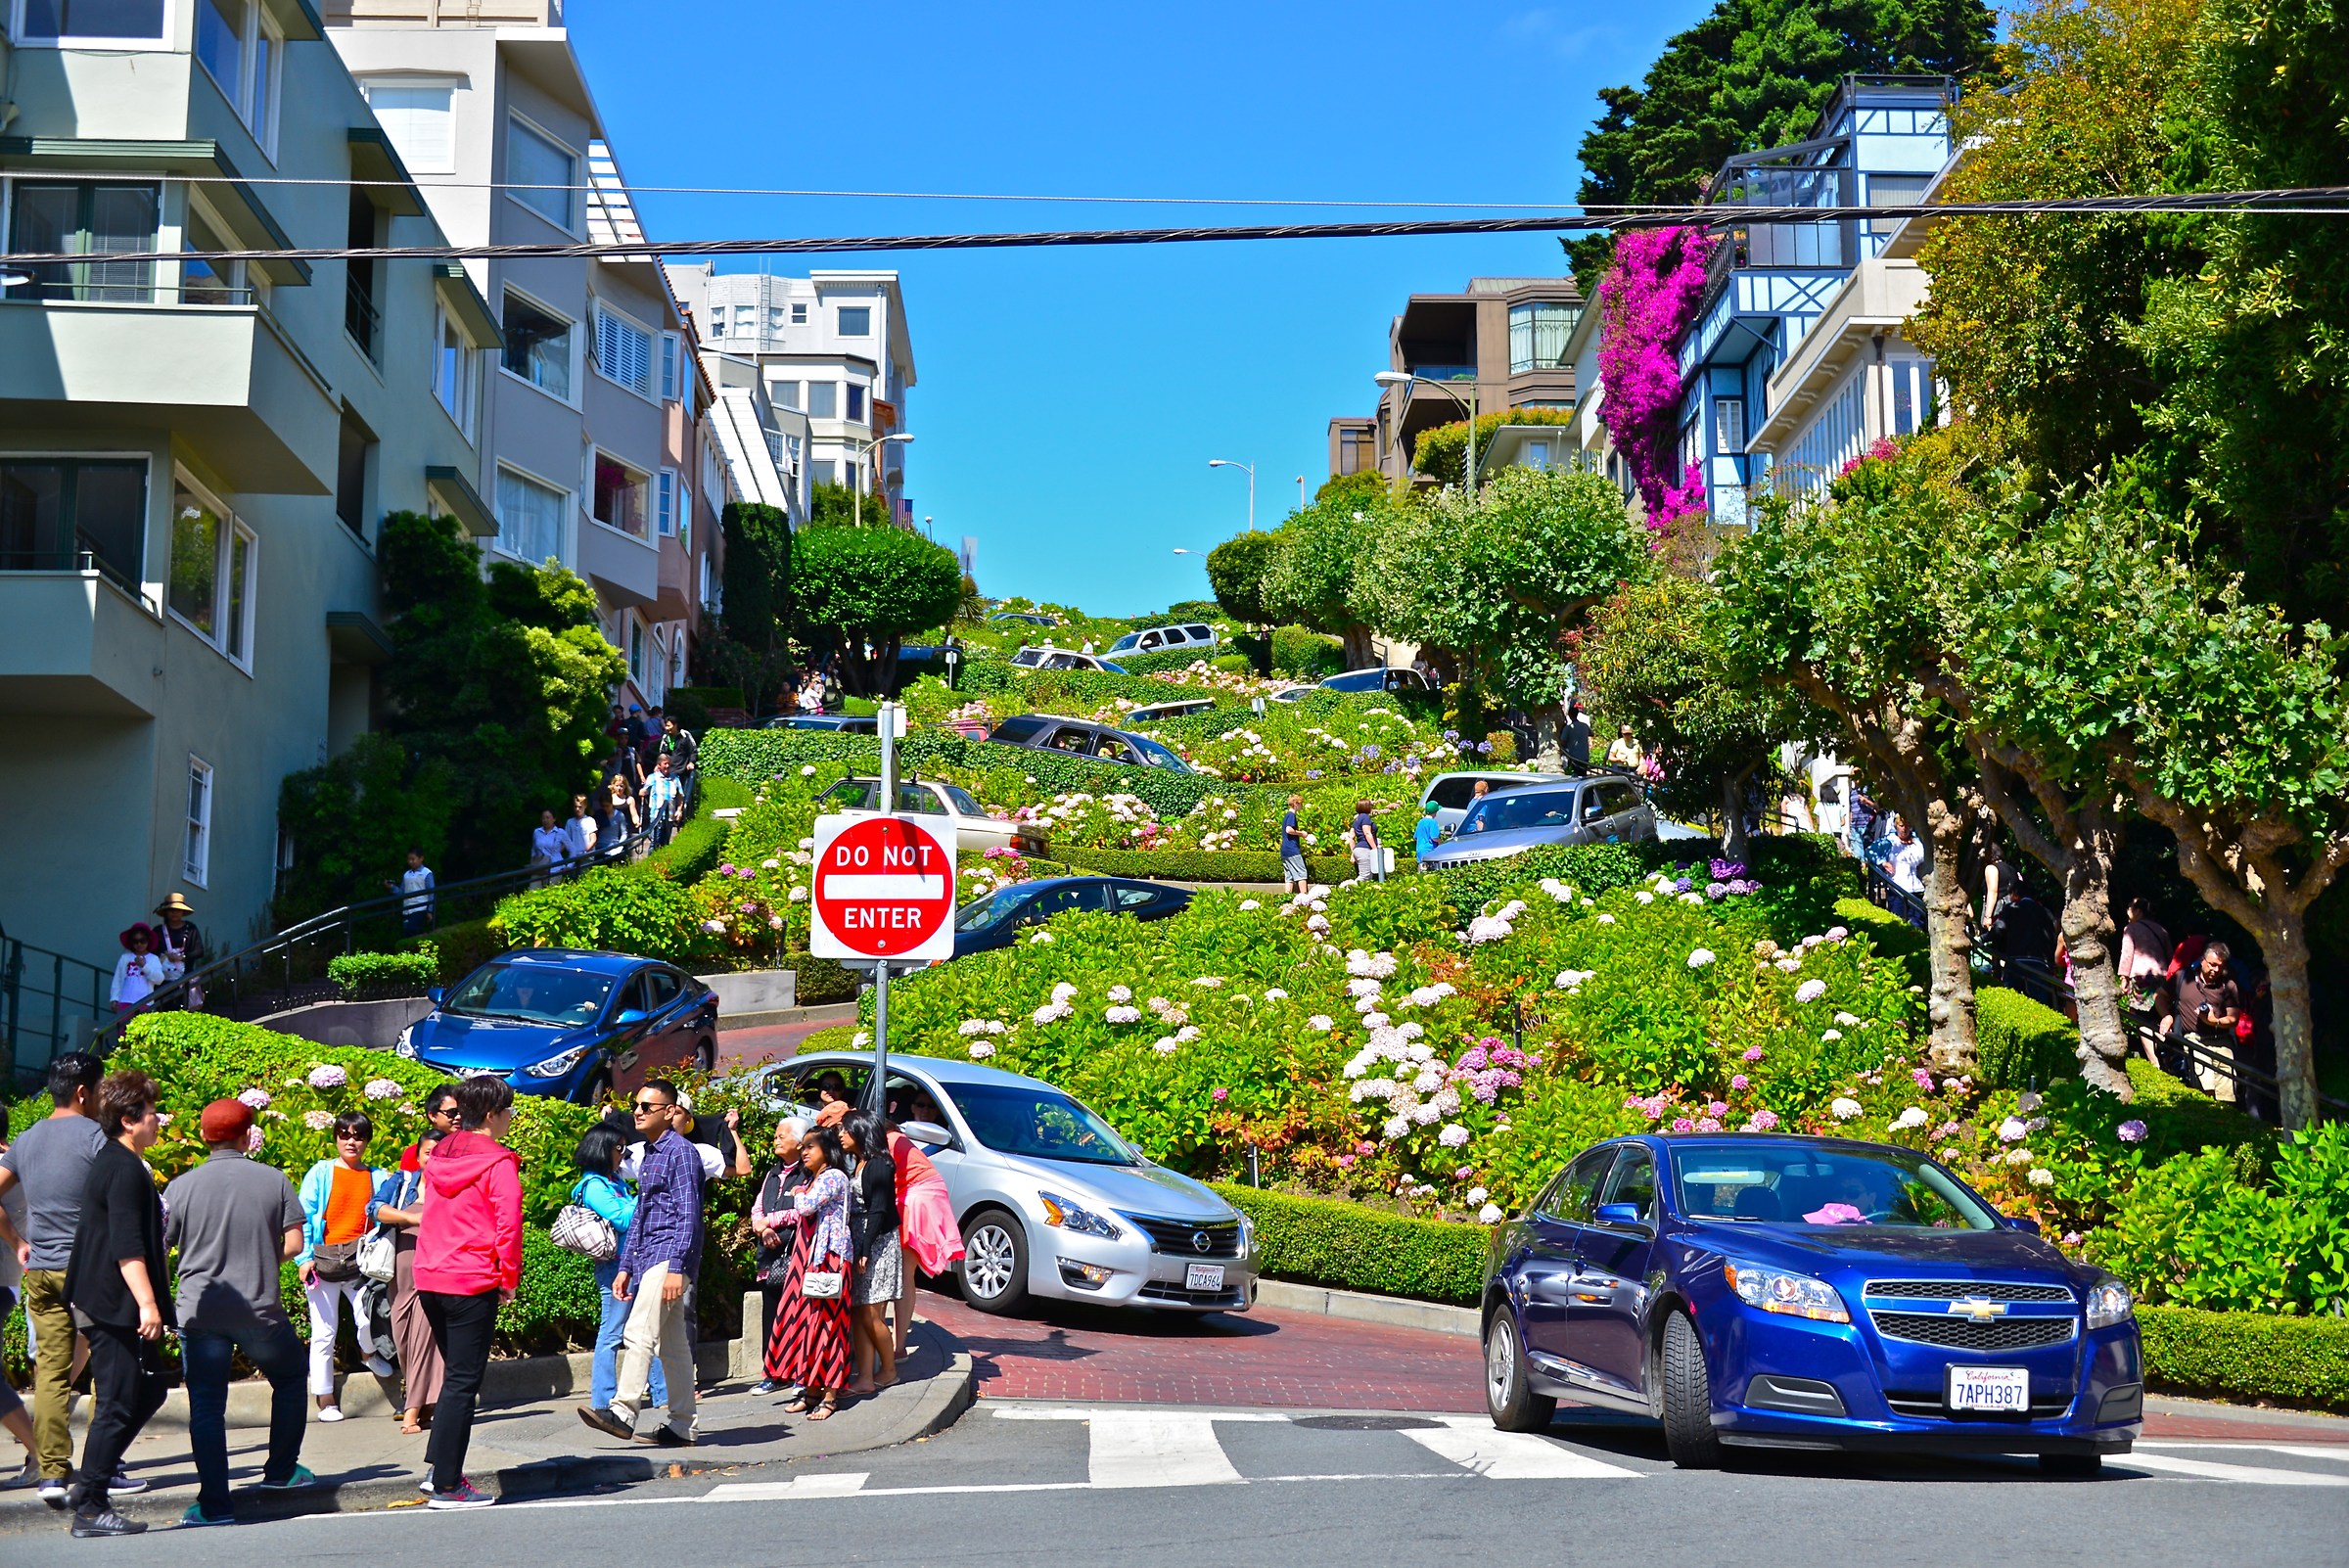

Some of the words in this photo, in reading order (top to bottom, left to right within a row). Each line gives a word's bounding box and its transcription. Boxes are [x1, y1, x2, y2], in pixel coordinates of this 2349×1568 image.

[836, 846, 869, 866] DO
[884, 846, 933, 866] NOT
[844, 907, 921, 928] ENTER
[1965, 1370, 2013, 1383] California
[1957, 1383, 2023, 1405] 7APH387
